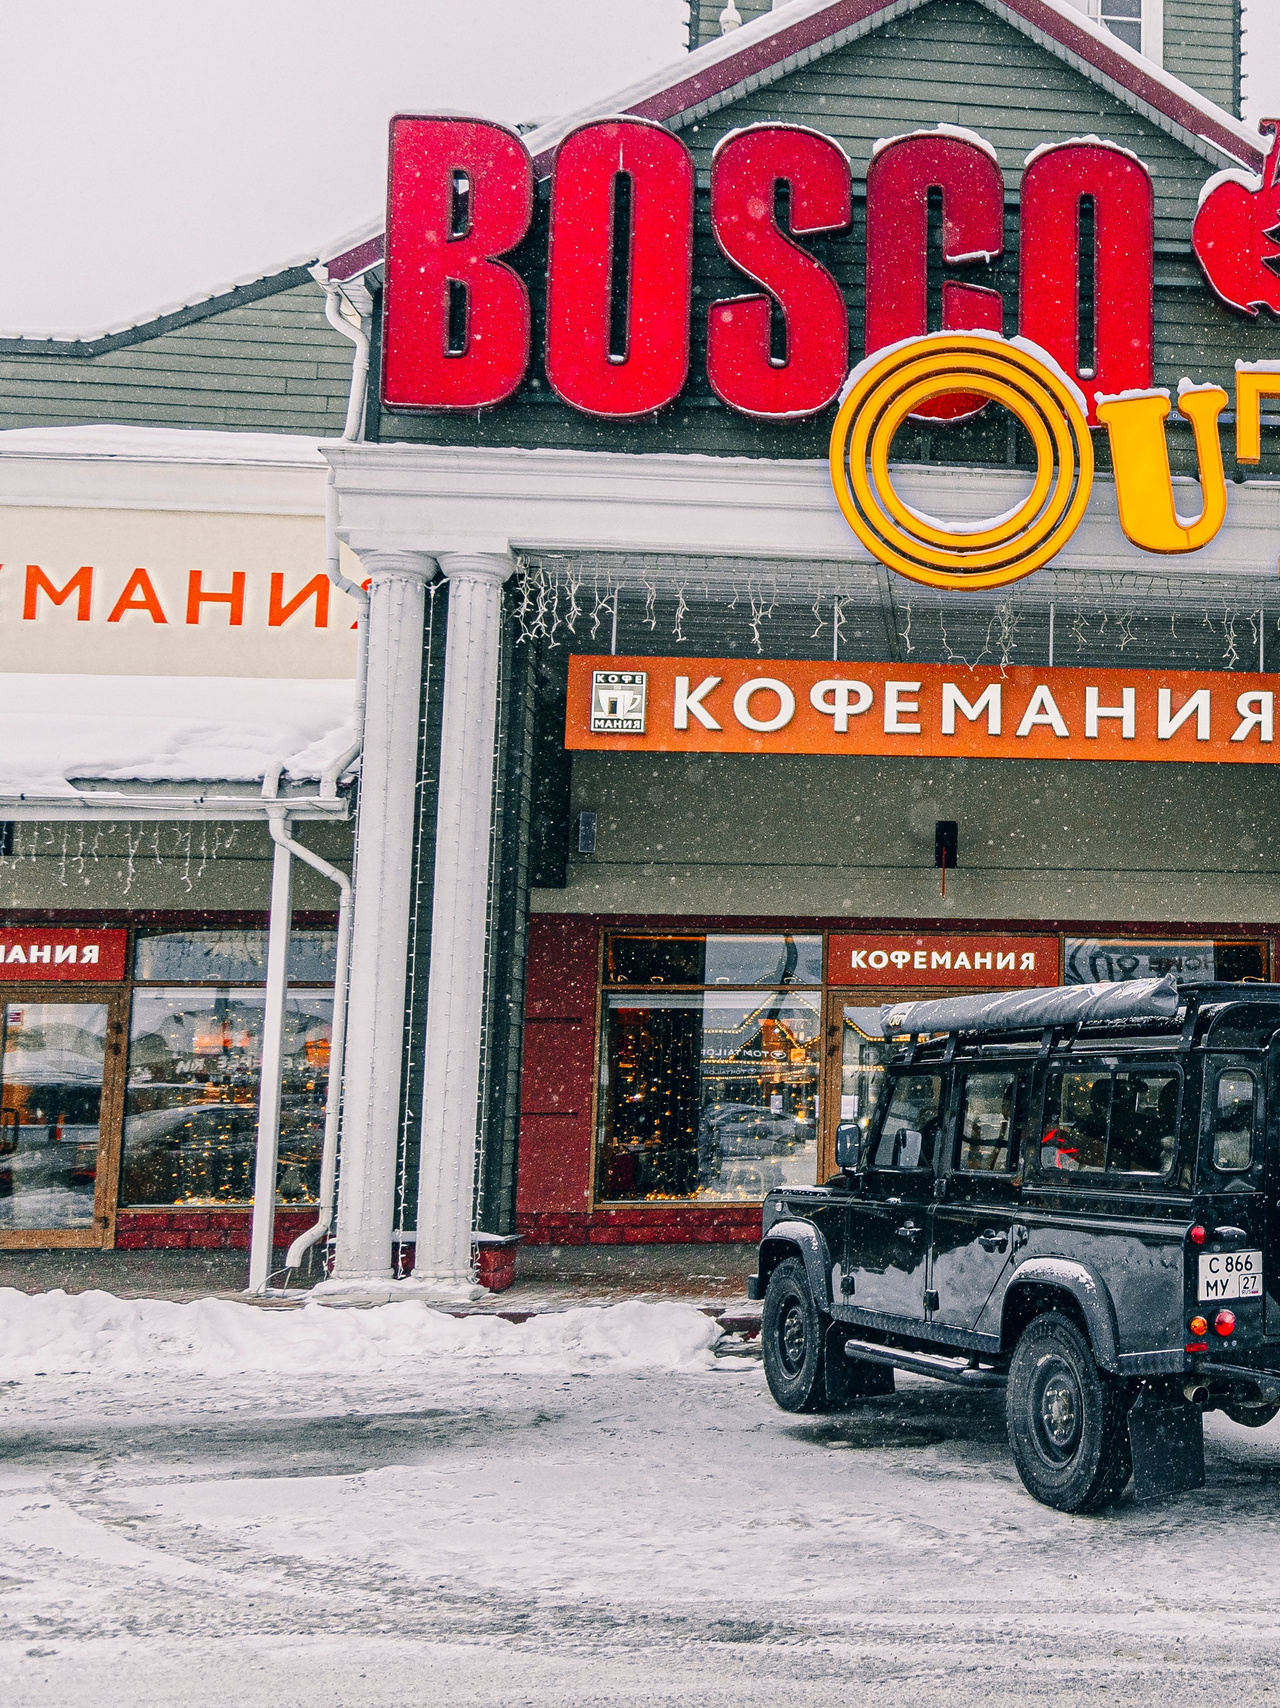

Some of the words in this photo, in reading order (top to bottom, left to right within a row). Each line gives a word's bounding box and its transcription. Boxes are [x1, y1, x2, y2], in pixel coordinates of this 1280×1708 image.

[379, 112, 1155, 428] BOSCO
[0, 564, 372, 629] МАНИ
[596, 674, 643, 684] КОФЕ
[673, 676, 1274, 743] КОФЕМАНИЯ
[594, 719, 641, 729] МАНИЯ
[851, 950, 1035, 970] КОФЕМАНИЯ
[1225, 1254, 1253, 1272] 866
[1242, 1275, 1257, 1290] 27
